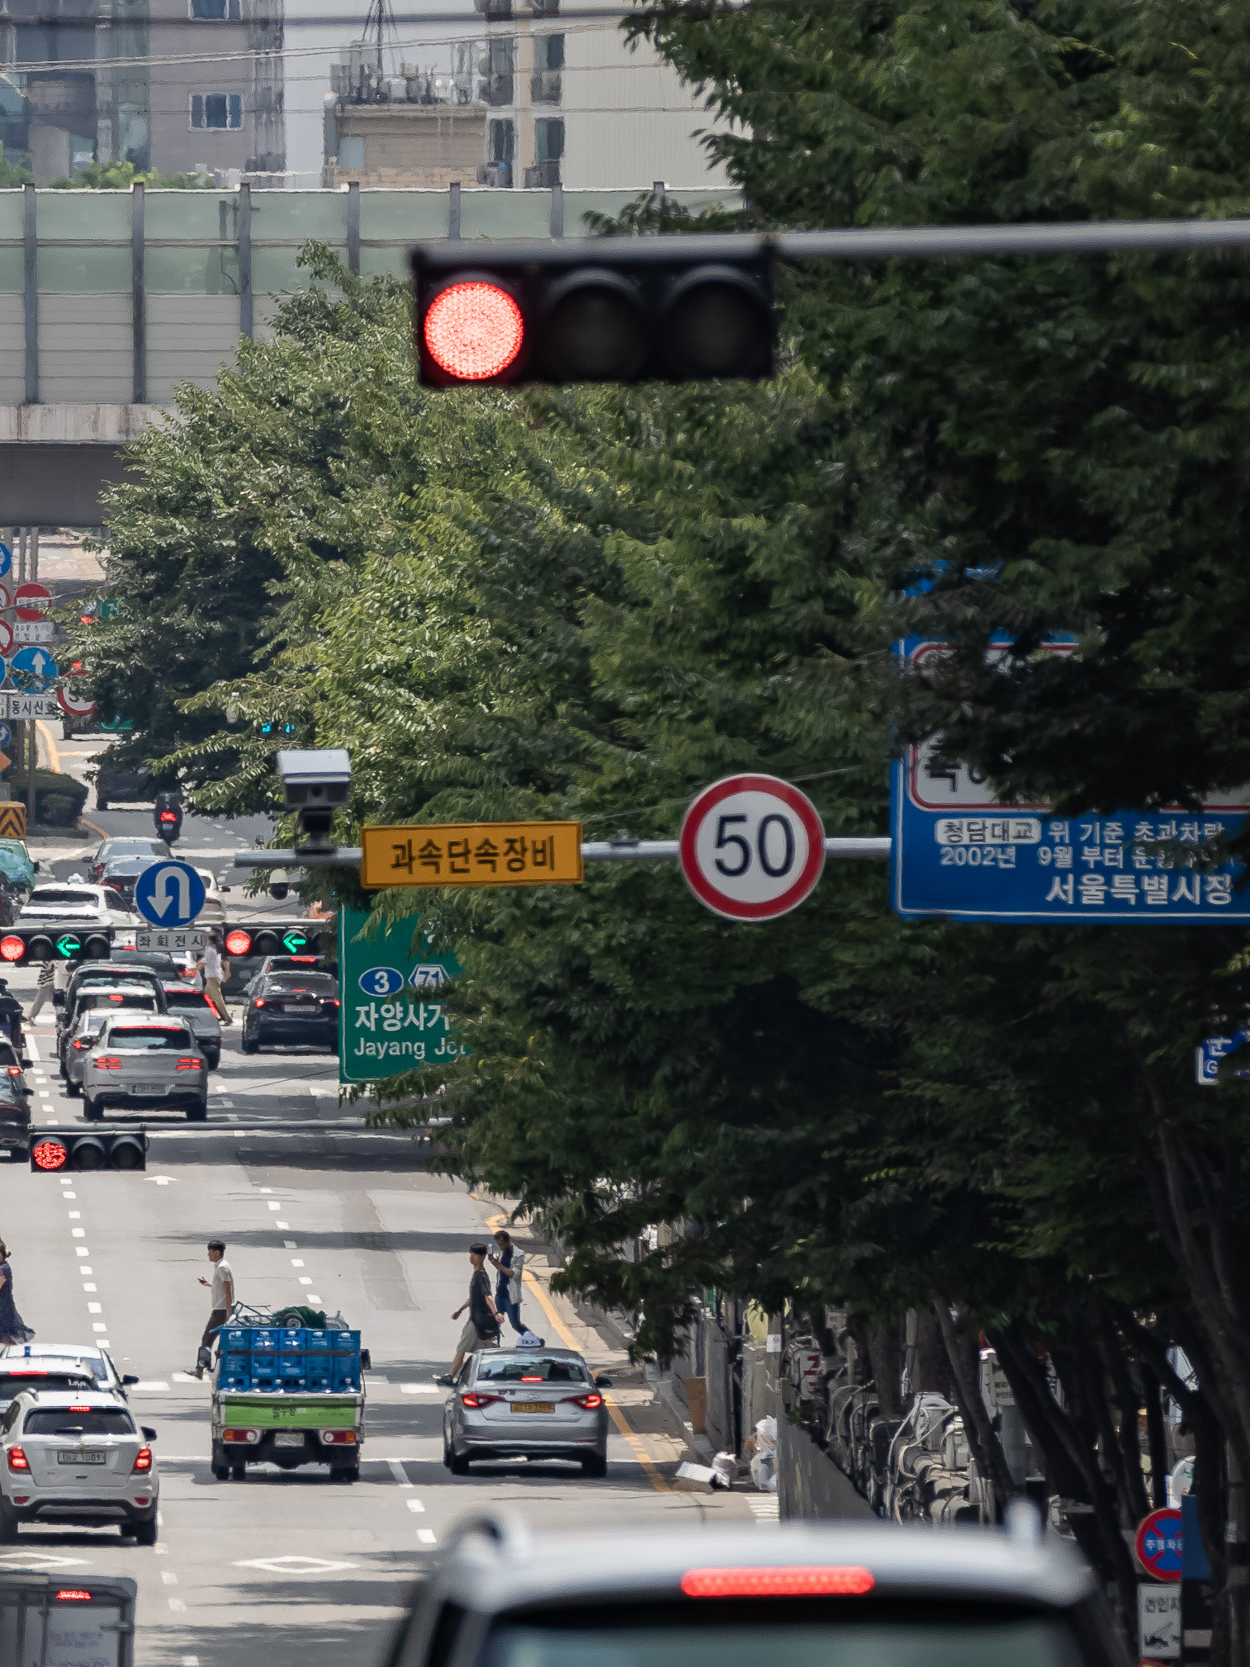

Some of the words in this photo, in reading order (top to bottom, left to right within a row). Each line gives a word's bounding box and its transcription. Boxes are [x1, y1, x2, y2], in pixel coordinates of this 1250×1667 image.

[11, 699, 57, 716] 동시신호
[944, 819, 1034, 844] 청담대교
[1047, 820, 1070, 844] 위
[1079, 821, 1125, 844] 기준
[390, 834, 555, 875] 과속단속장비
[714, 812, 797, 878] 50
[939, 845, 1017, 869] 2002년
[1037, 845, 1074, 869] 9월
[1081, 845, 1124, 869] 부터
[1045, 872, 1232, 906] 서울특별시장
[139, 934, 204, 948] 좌회전시
[373, 970, 391, 994] 3
[418, 970, 446, 988] 71
[353, 1037, 427, 1060] Jayang
